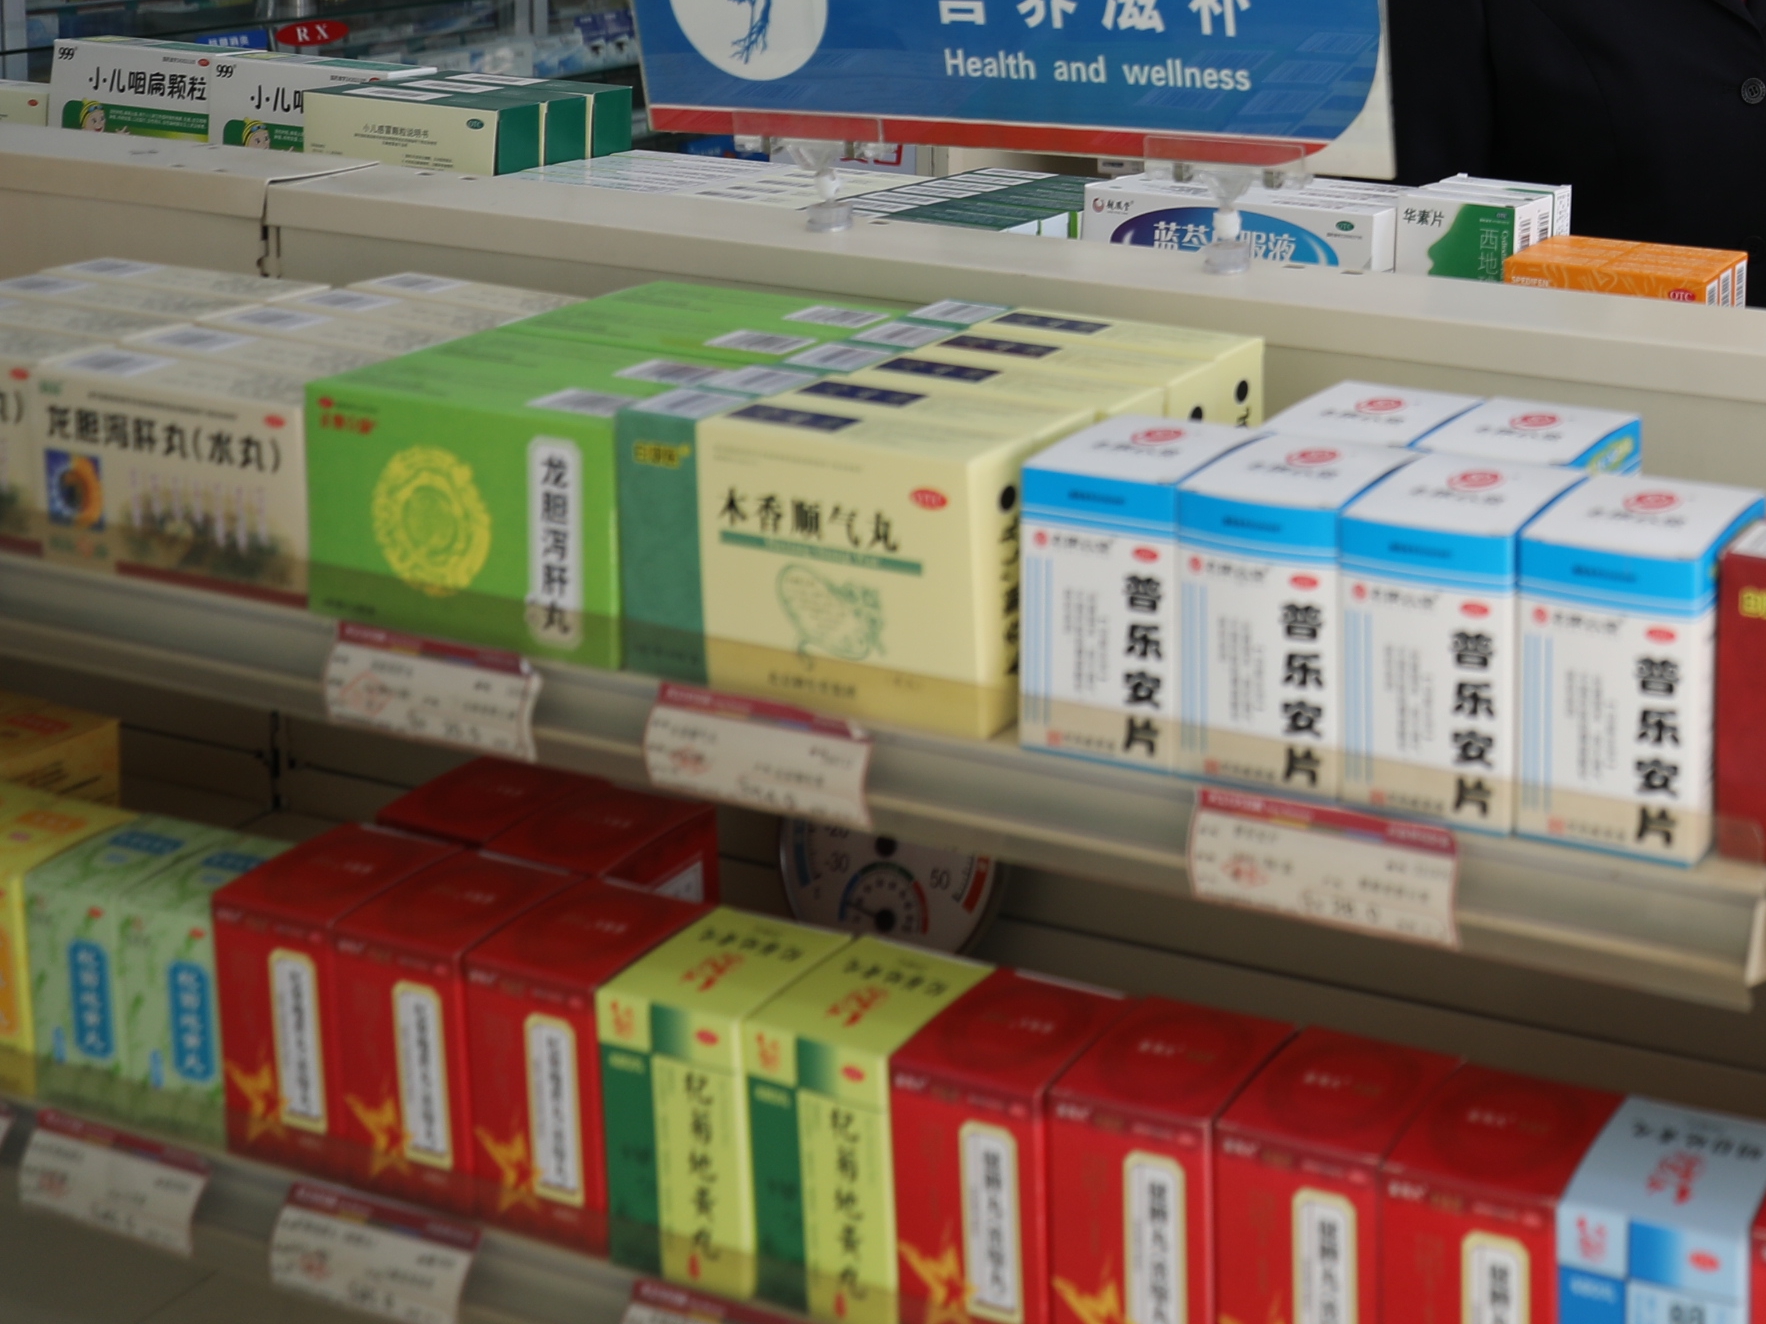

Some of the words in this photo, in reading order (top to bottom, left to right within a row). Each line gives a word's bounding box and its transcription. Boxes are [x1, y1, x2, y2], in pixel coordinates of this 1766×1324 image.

[296, 24, 330, 42] RX
[58, 46, 76, 61] 999
[215, 64, 234, 79] 999
[945, 48, 1036, 80] Health
[1054, 54, 1105, 84] and
[1122, 59, 1252, 92] wellness
[88, 66, 207, 102] 小儿咽扁颗粒
[1403, 207, 1444, 228] 华素片
[1154, 221, 1297, 261] 蓝芩服液
[1478, 228, 1499, 283] 西地
[1669, 291, 1693, 302] OTC
[718, 486, 900, 553] 木香顺气丸
[540, 454, 571, 635] 龙胆泻肝丸
[1123, 574, 1165, 758] 普乐安片
[1281, 602, 1324, 788] 普乐安片
[1450, 628, 1495, 821] 普乐安片
[1634, 656, 1680, 849] 普乐安片
[826, 854, 849, 873] -30
[929, 869, 950, 890] 50
